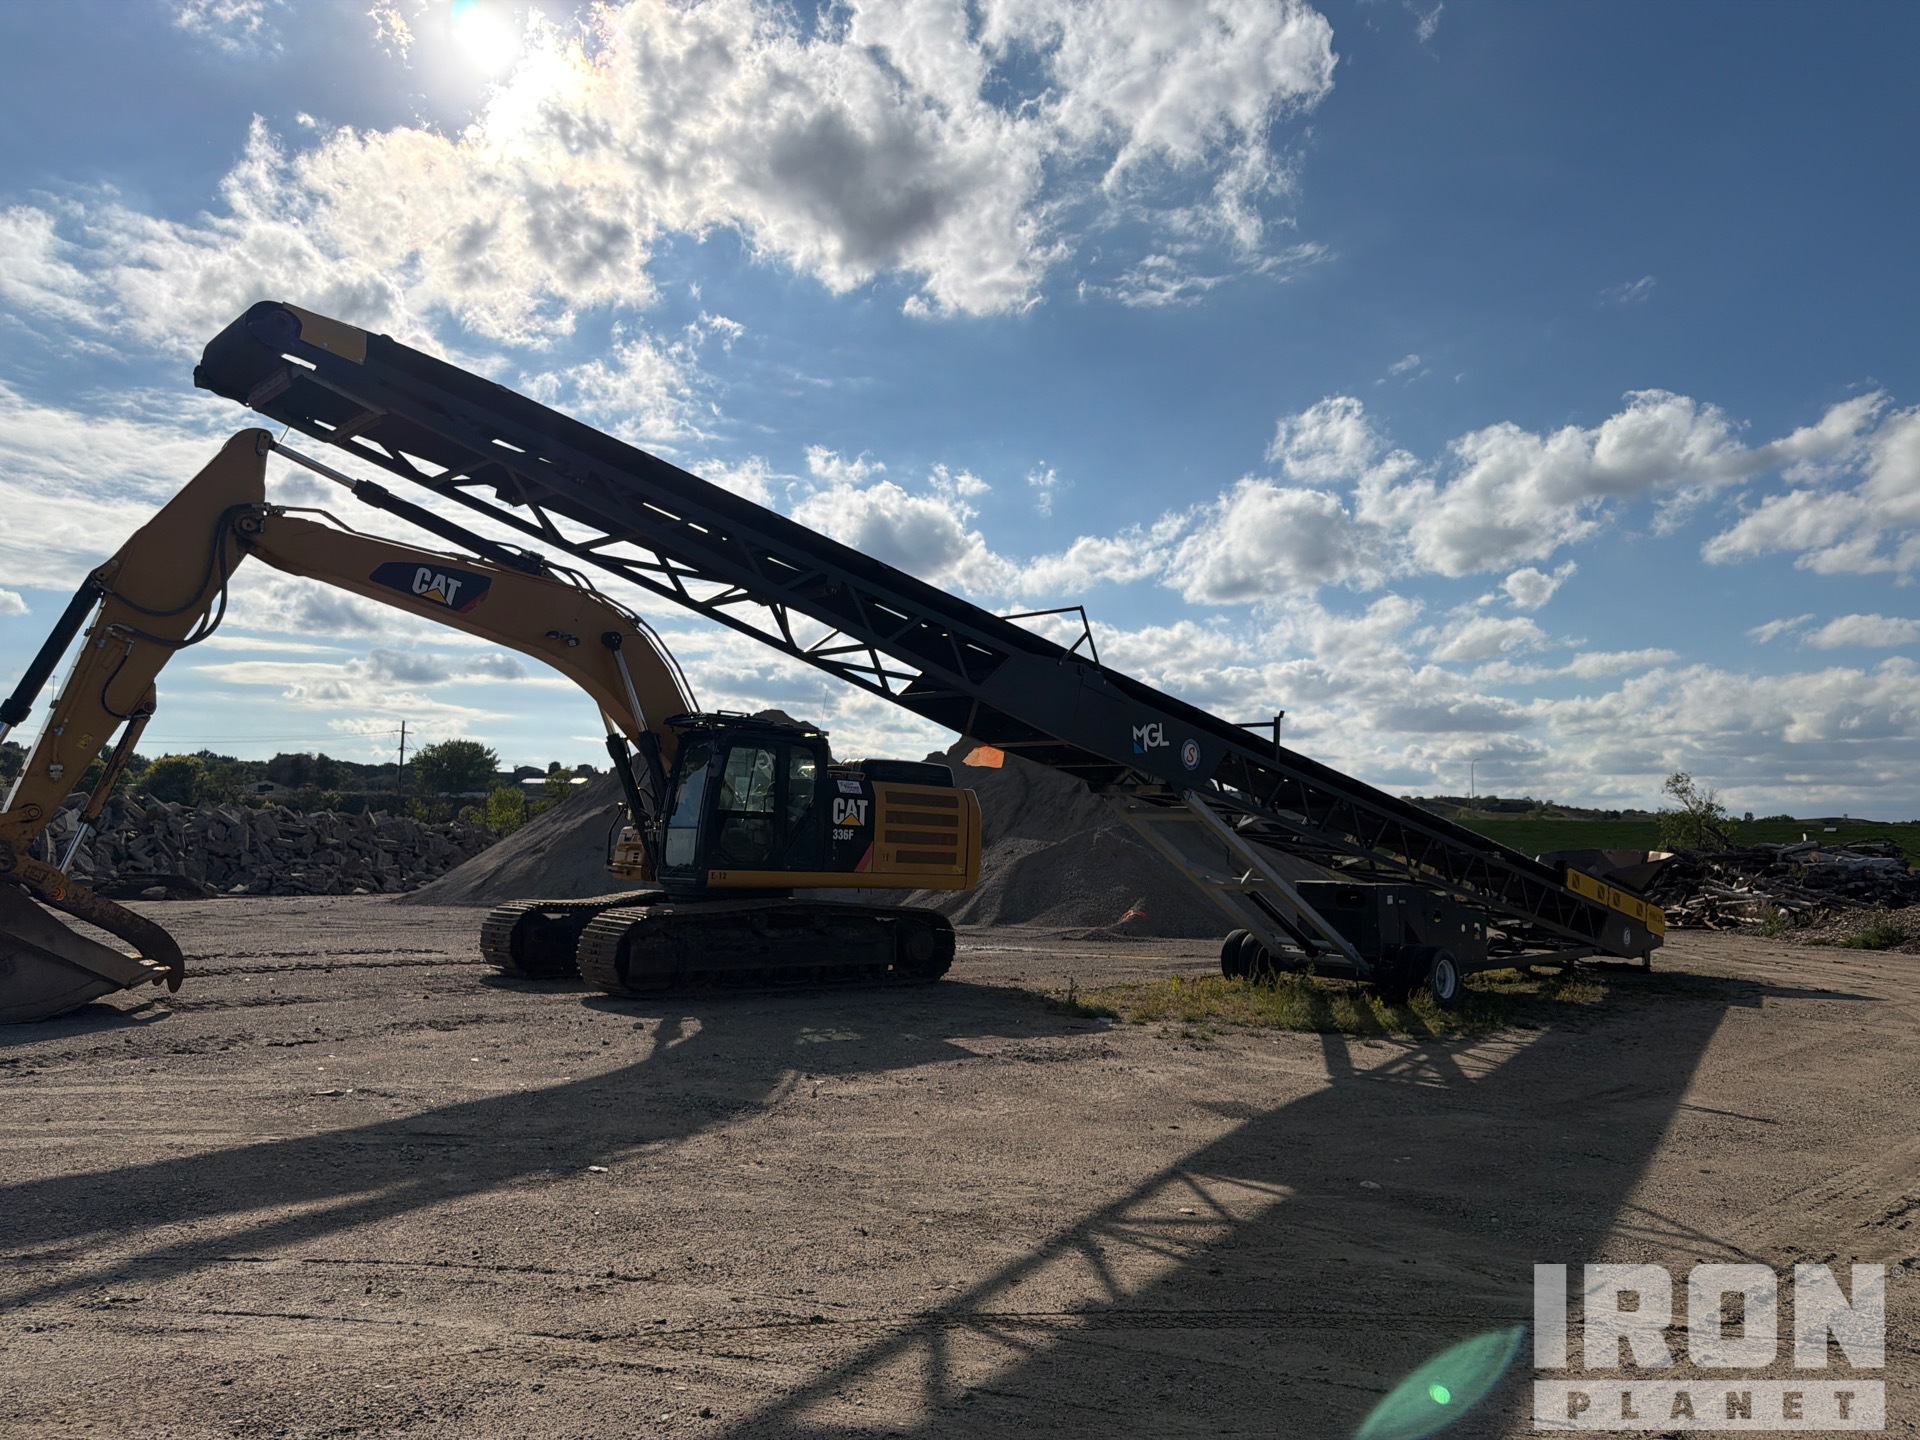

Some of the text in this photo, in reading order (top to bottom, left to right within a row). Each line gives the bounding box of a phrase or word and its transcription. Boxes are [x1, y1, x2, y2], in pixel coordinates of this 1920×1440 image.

[412, 567, 462, 606] CAT
[1132, 722, 1170, 752] MGL
[832, 797, 869, 827] CAT
[832, 828, 854, 840] 336F
